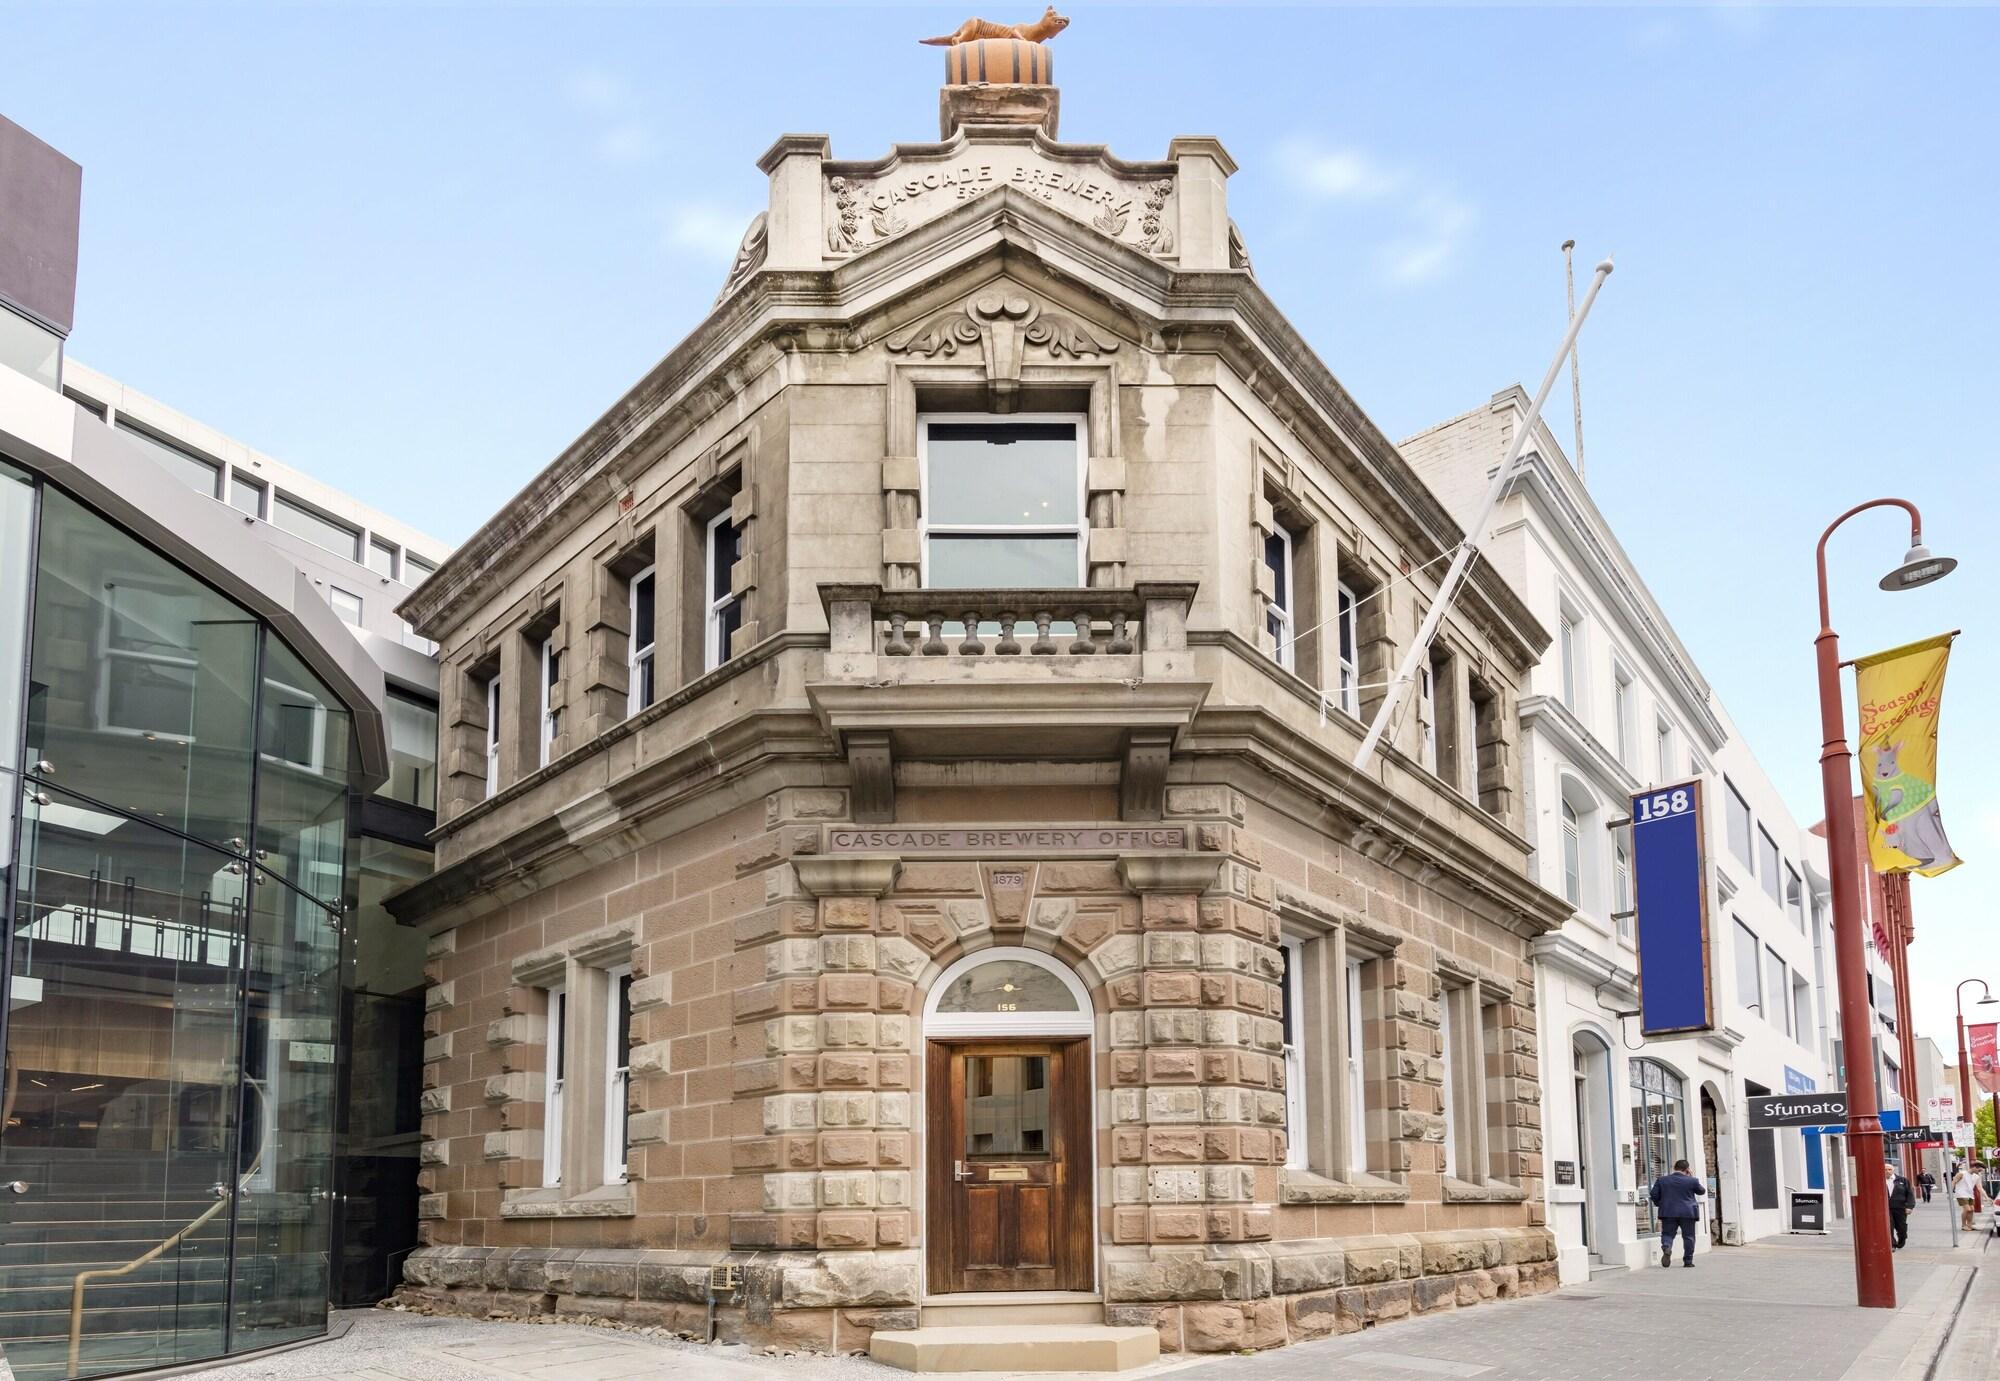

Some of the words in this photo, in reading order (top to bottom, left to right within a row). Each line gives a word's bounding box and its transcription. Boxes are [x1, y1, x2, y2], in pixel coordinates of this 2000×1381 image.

[871, 163, 993, 211] CASCADE
[1010, 165, 1132, 217] BREWERY
[1639, 789, 1689, 820] 158
[835, 832, 951, 847] CASCADE
[966, 831, 1083, 846] BREWERY
[1098, 831, 1179, 846] OFFICE
[994, 875, 1021, 885] 1879
[997, 1003, 1016, 1012] 156
[1764, 1102, 1844, 1116] Sfumato
